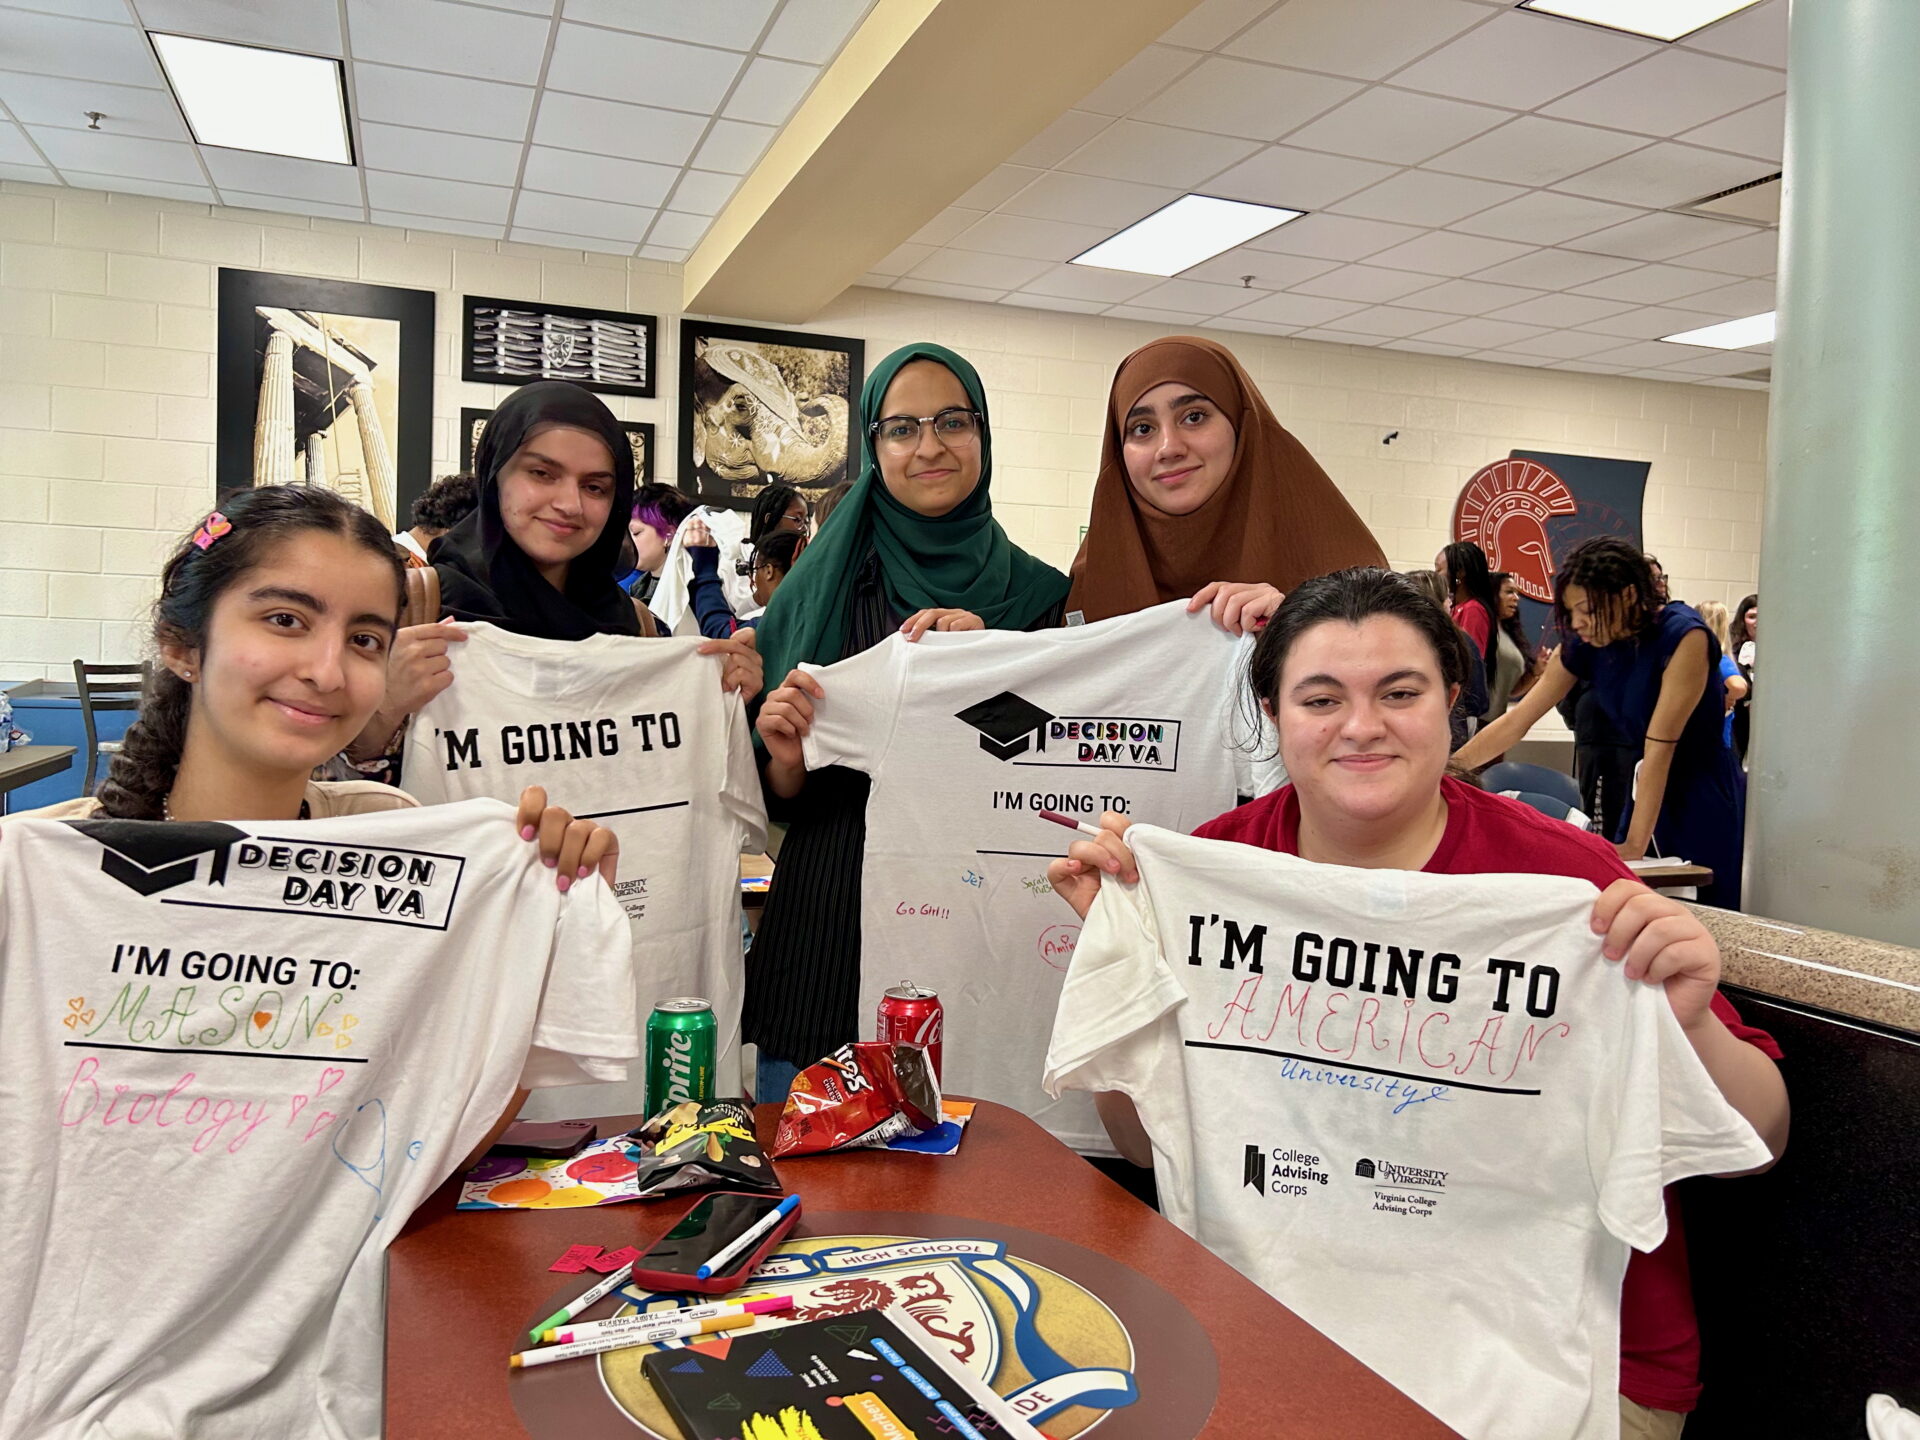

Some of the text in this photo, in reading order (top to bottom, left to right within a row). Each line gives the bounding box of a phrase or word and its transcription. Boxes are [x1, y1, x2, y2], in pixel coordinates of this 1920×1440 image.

[435, 711, 682, 771] 'M GOING TO
[1050, 721, 1163, 743] DECISION
[1078, 743, 1162, 765] DAY VA
[992, 791, 1131, 815] I'M GOING TO:
[238, 843, 438, 886] DECISION
[614, 878, 647, 889] VERSITY
[283, 876, 427, 920] DAY VA
[896, 901, 916, 915] Go
[1045, 939, 1076, 956] Amin
[112, 944, 361, 992] I'M GOING TO:
[1188, 913, 1560, 1019] I'M GOING TO
[85, 982, 344, 1050] MASON
[1207, 974, 1570, 1083] AMERICAN
[1281, 1058, 1420, 1115] University
[59, 1057, 272, 1154] Biology
[1273, 1148, 1319, 1166] College
[1272, 1164, 1329, 1185] Advising
[1378, 1160, 1448, 1180] UNIVERSITY
[1271, 1180, 1307, 1197] Corps
[1374, 1191, 1437, 1207] Virginia College
[1372, 1202, 1432, 1217] Advising Corps
[843, 1244, 982, 1266] HIGH SCHOOL
[1011, 1391, 1054, 1416] IDE
